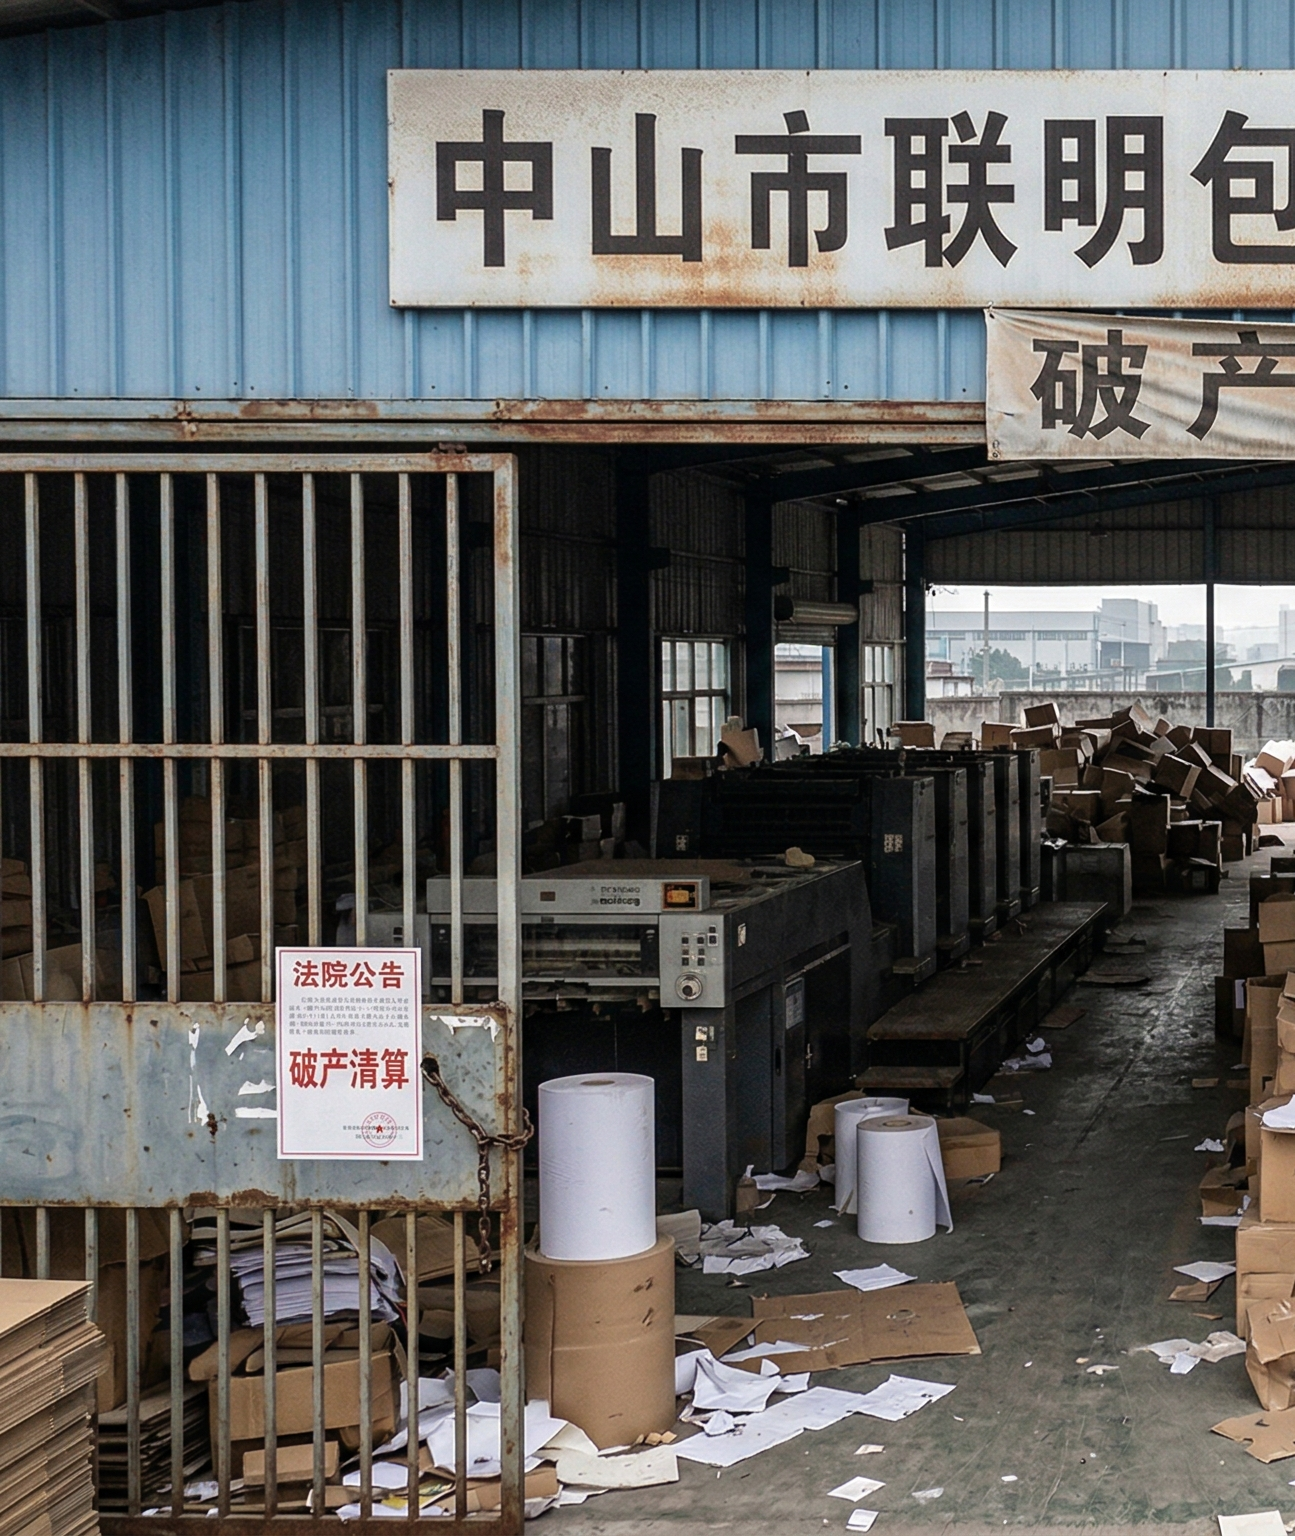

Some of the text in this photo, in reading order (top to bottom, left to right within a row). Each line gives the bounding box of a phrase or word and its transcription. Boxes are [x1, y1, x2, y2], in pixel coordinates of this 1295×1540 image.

[293, 960, 405, 989] 法院公告
[289, 1048, 410, 1090] 破产清算
